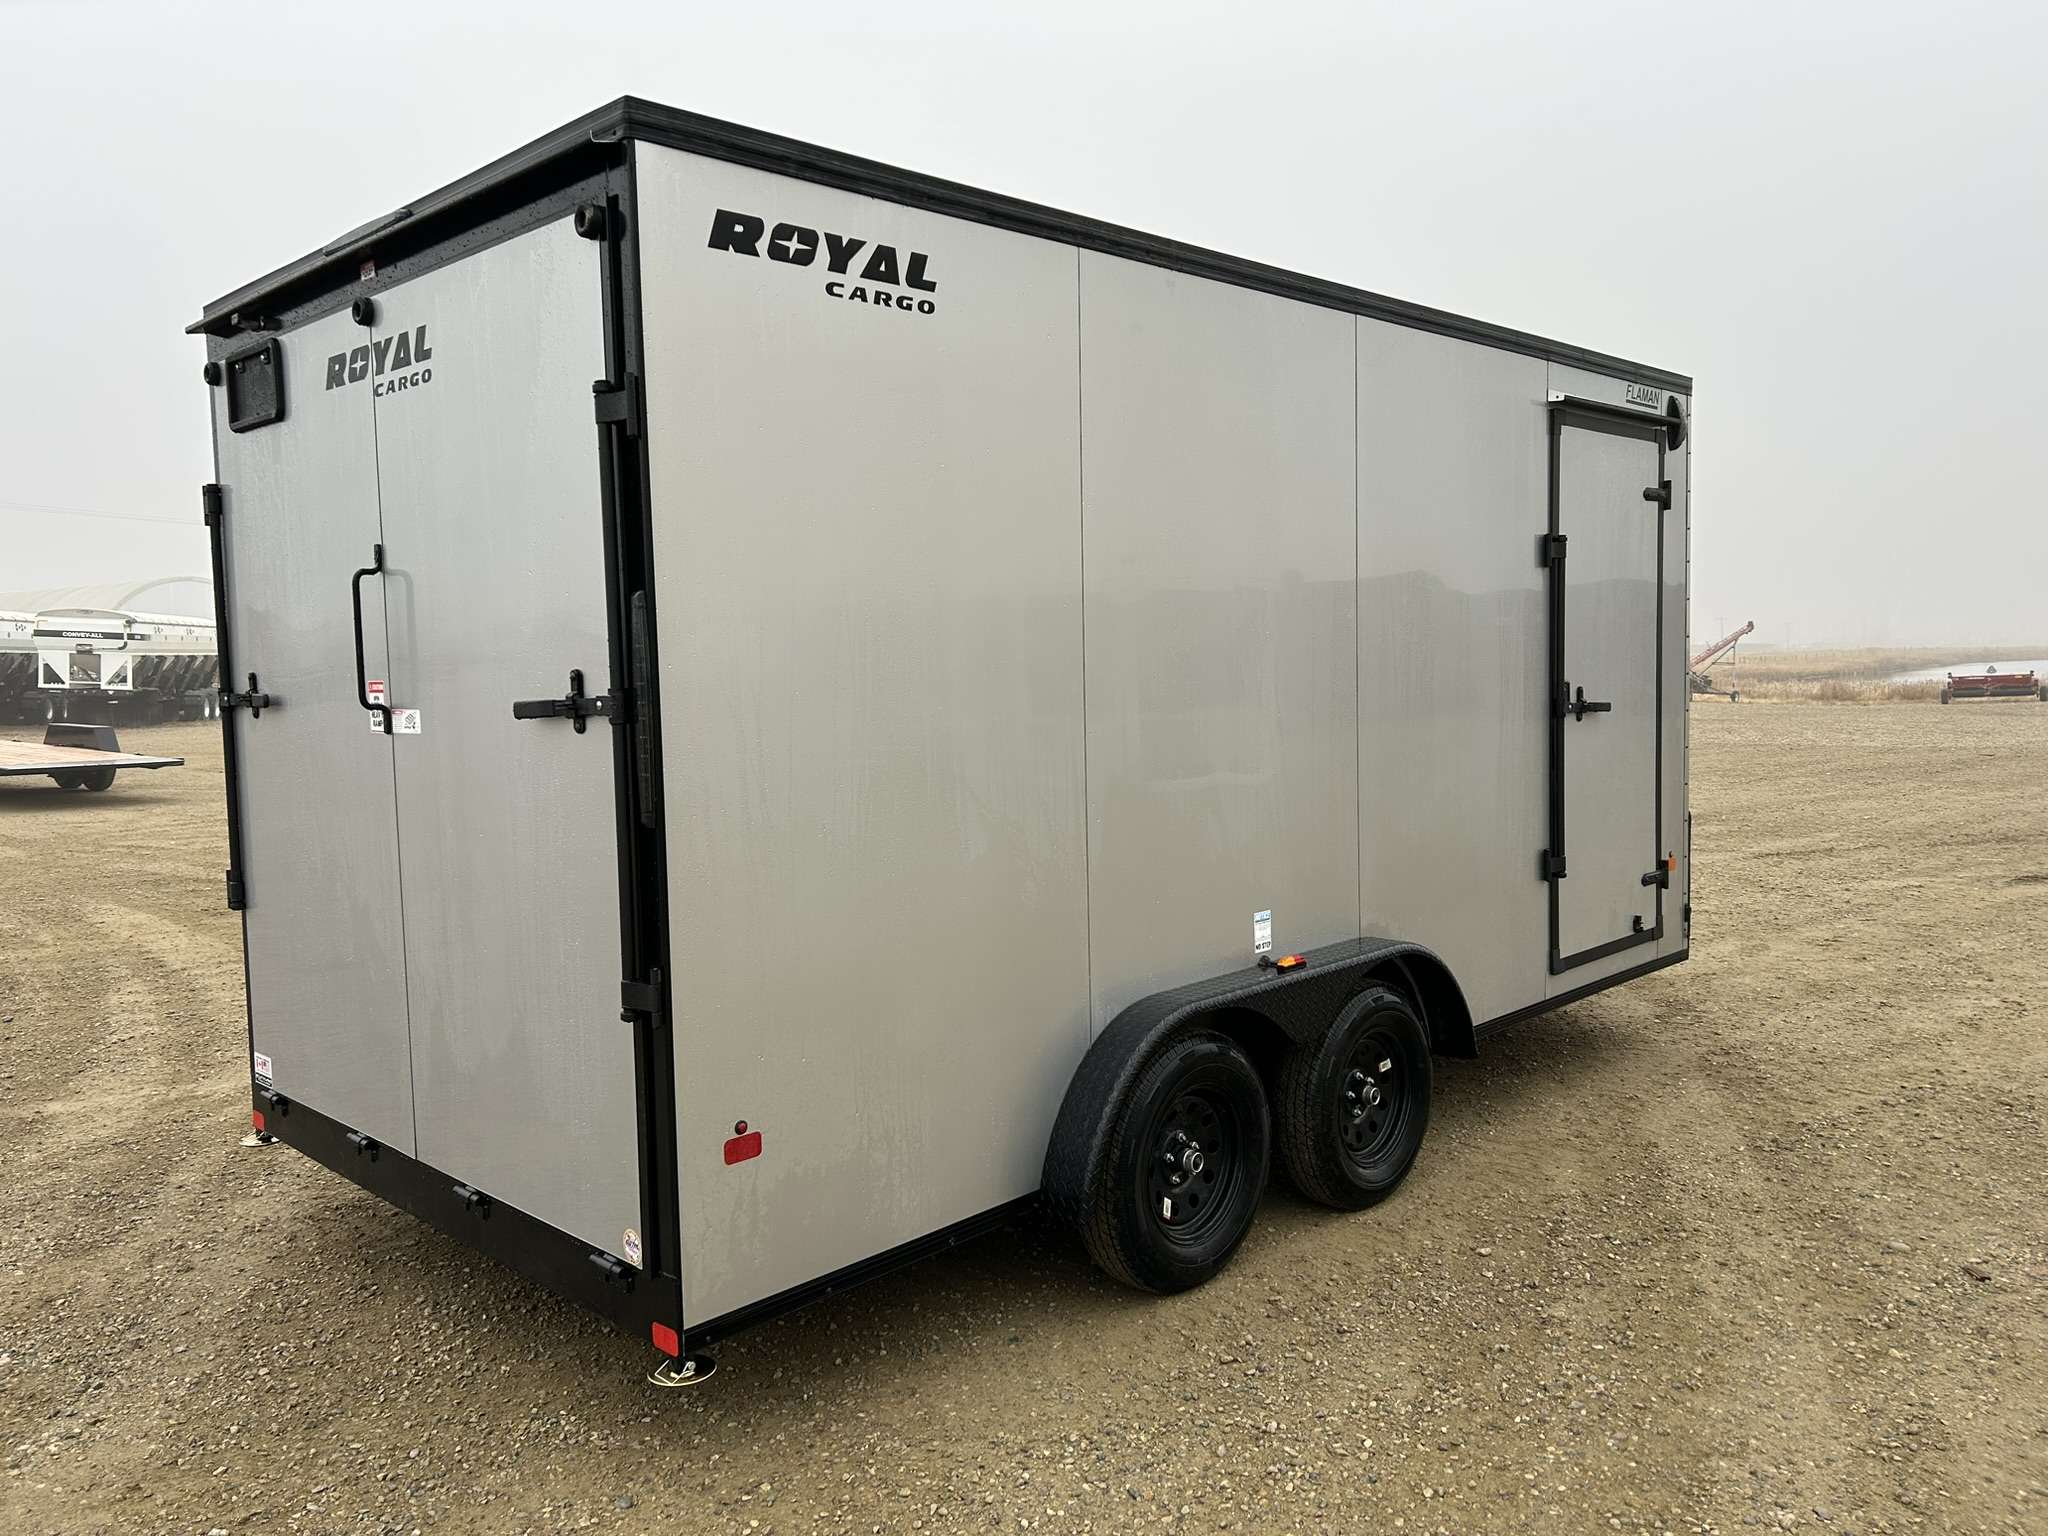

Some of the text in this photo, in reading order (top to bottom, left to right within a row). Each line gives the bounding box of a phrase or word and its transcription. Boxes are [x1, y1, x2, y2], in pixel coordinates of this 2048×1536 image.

[708, 209, 937, 293] ROYAL
[825, 281, 936, 315] CARGO
[326, 324, 433, 391] ROYAL
[374, 368, 433, 398] CARGO
[1626, 384, 1661, 405] FLAMAN
[62, 631, 104, 639] CONVEY-ALL
